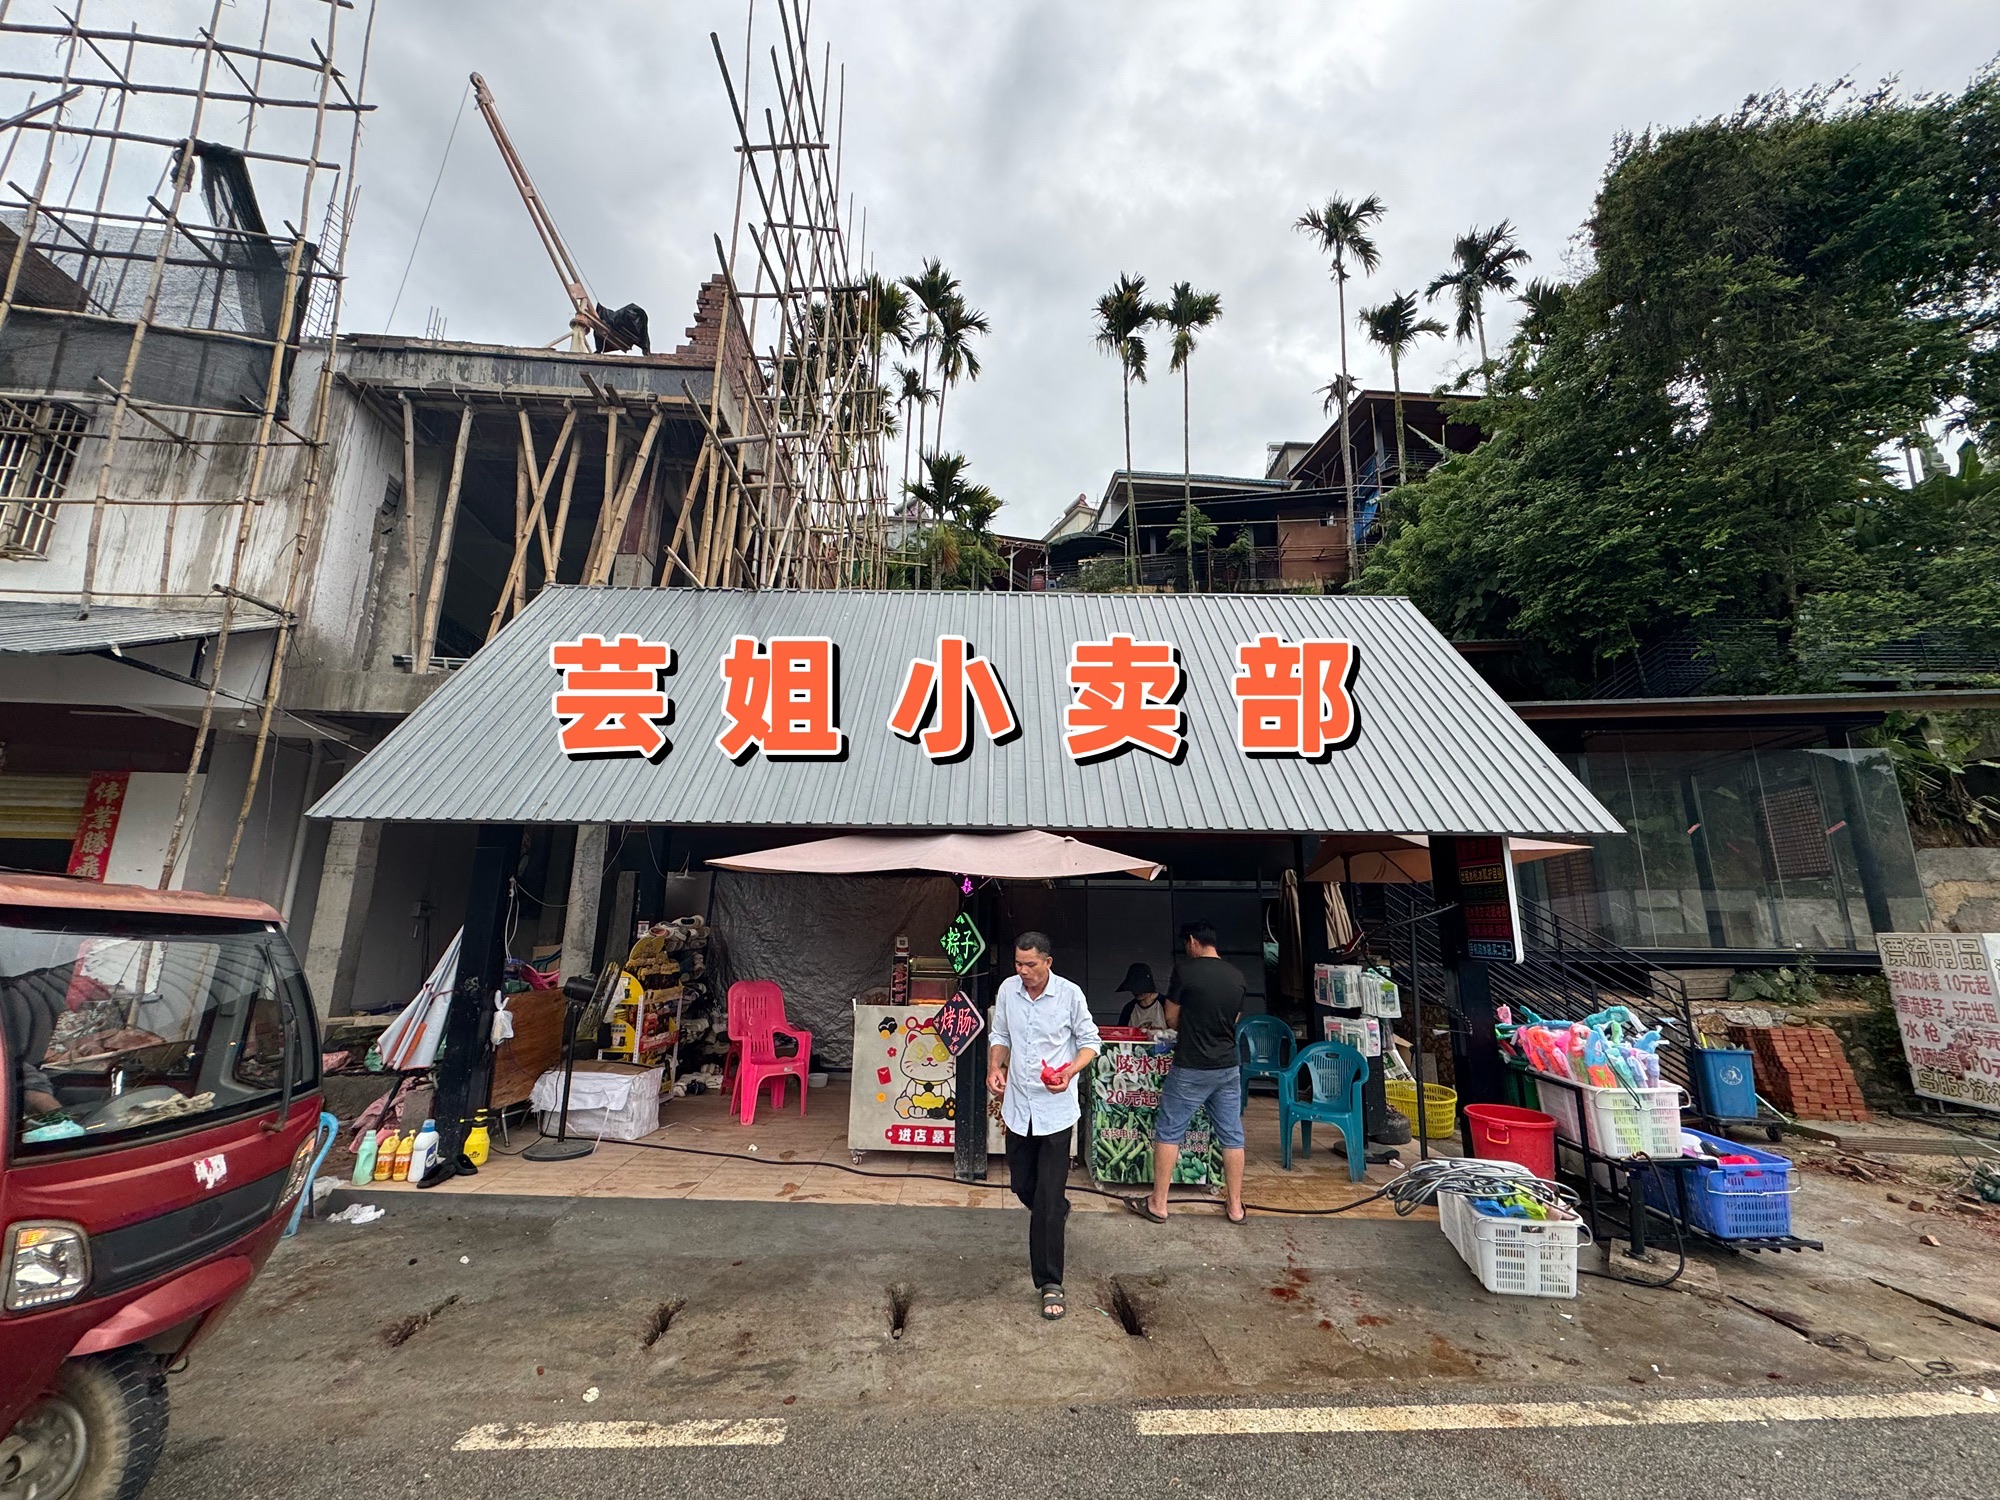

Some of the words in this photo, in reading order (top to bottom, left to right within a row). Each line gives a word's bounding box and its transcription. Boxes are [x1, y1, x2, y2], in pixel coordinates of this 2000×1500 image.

[946, 927, 974, 959] 粽子
[1880, 937, 1987, 971] 漂流用品
[1944, 973, 1992, 996] 10元起
[940, 1006, 972, 1037] 烤肠
[1952, 1001, 1999, 1024] 5元出租
